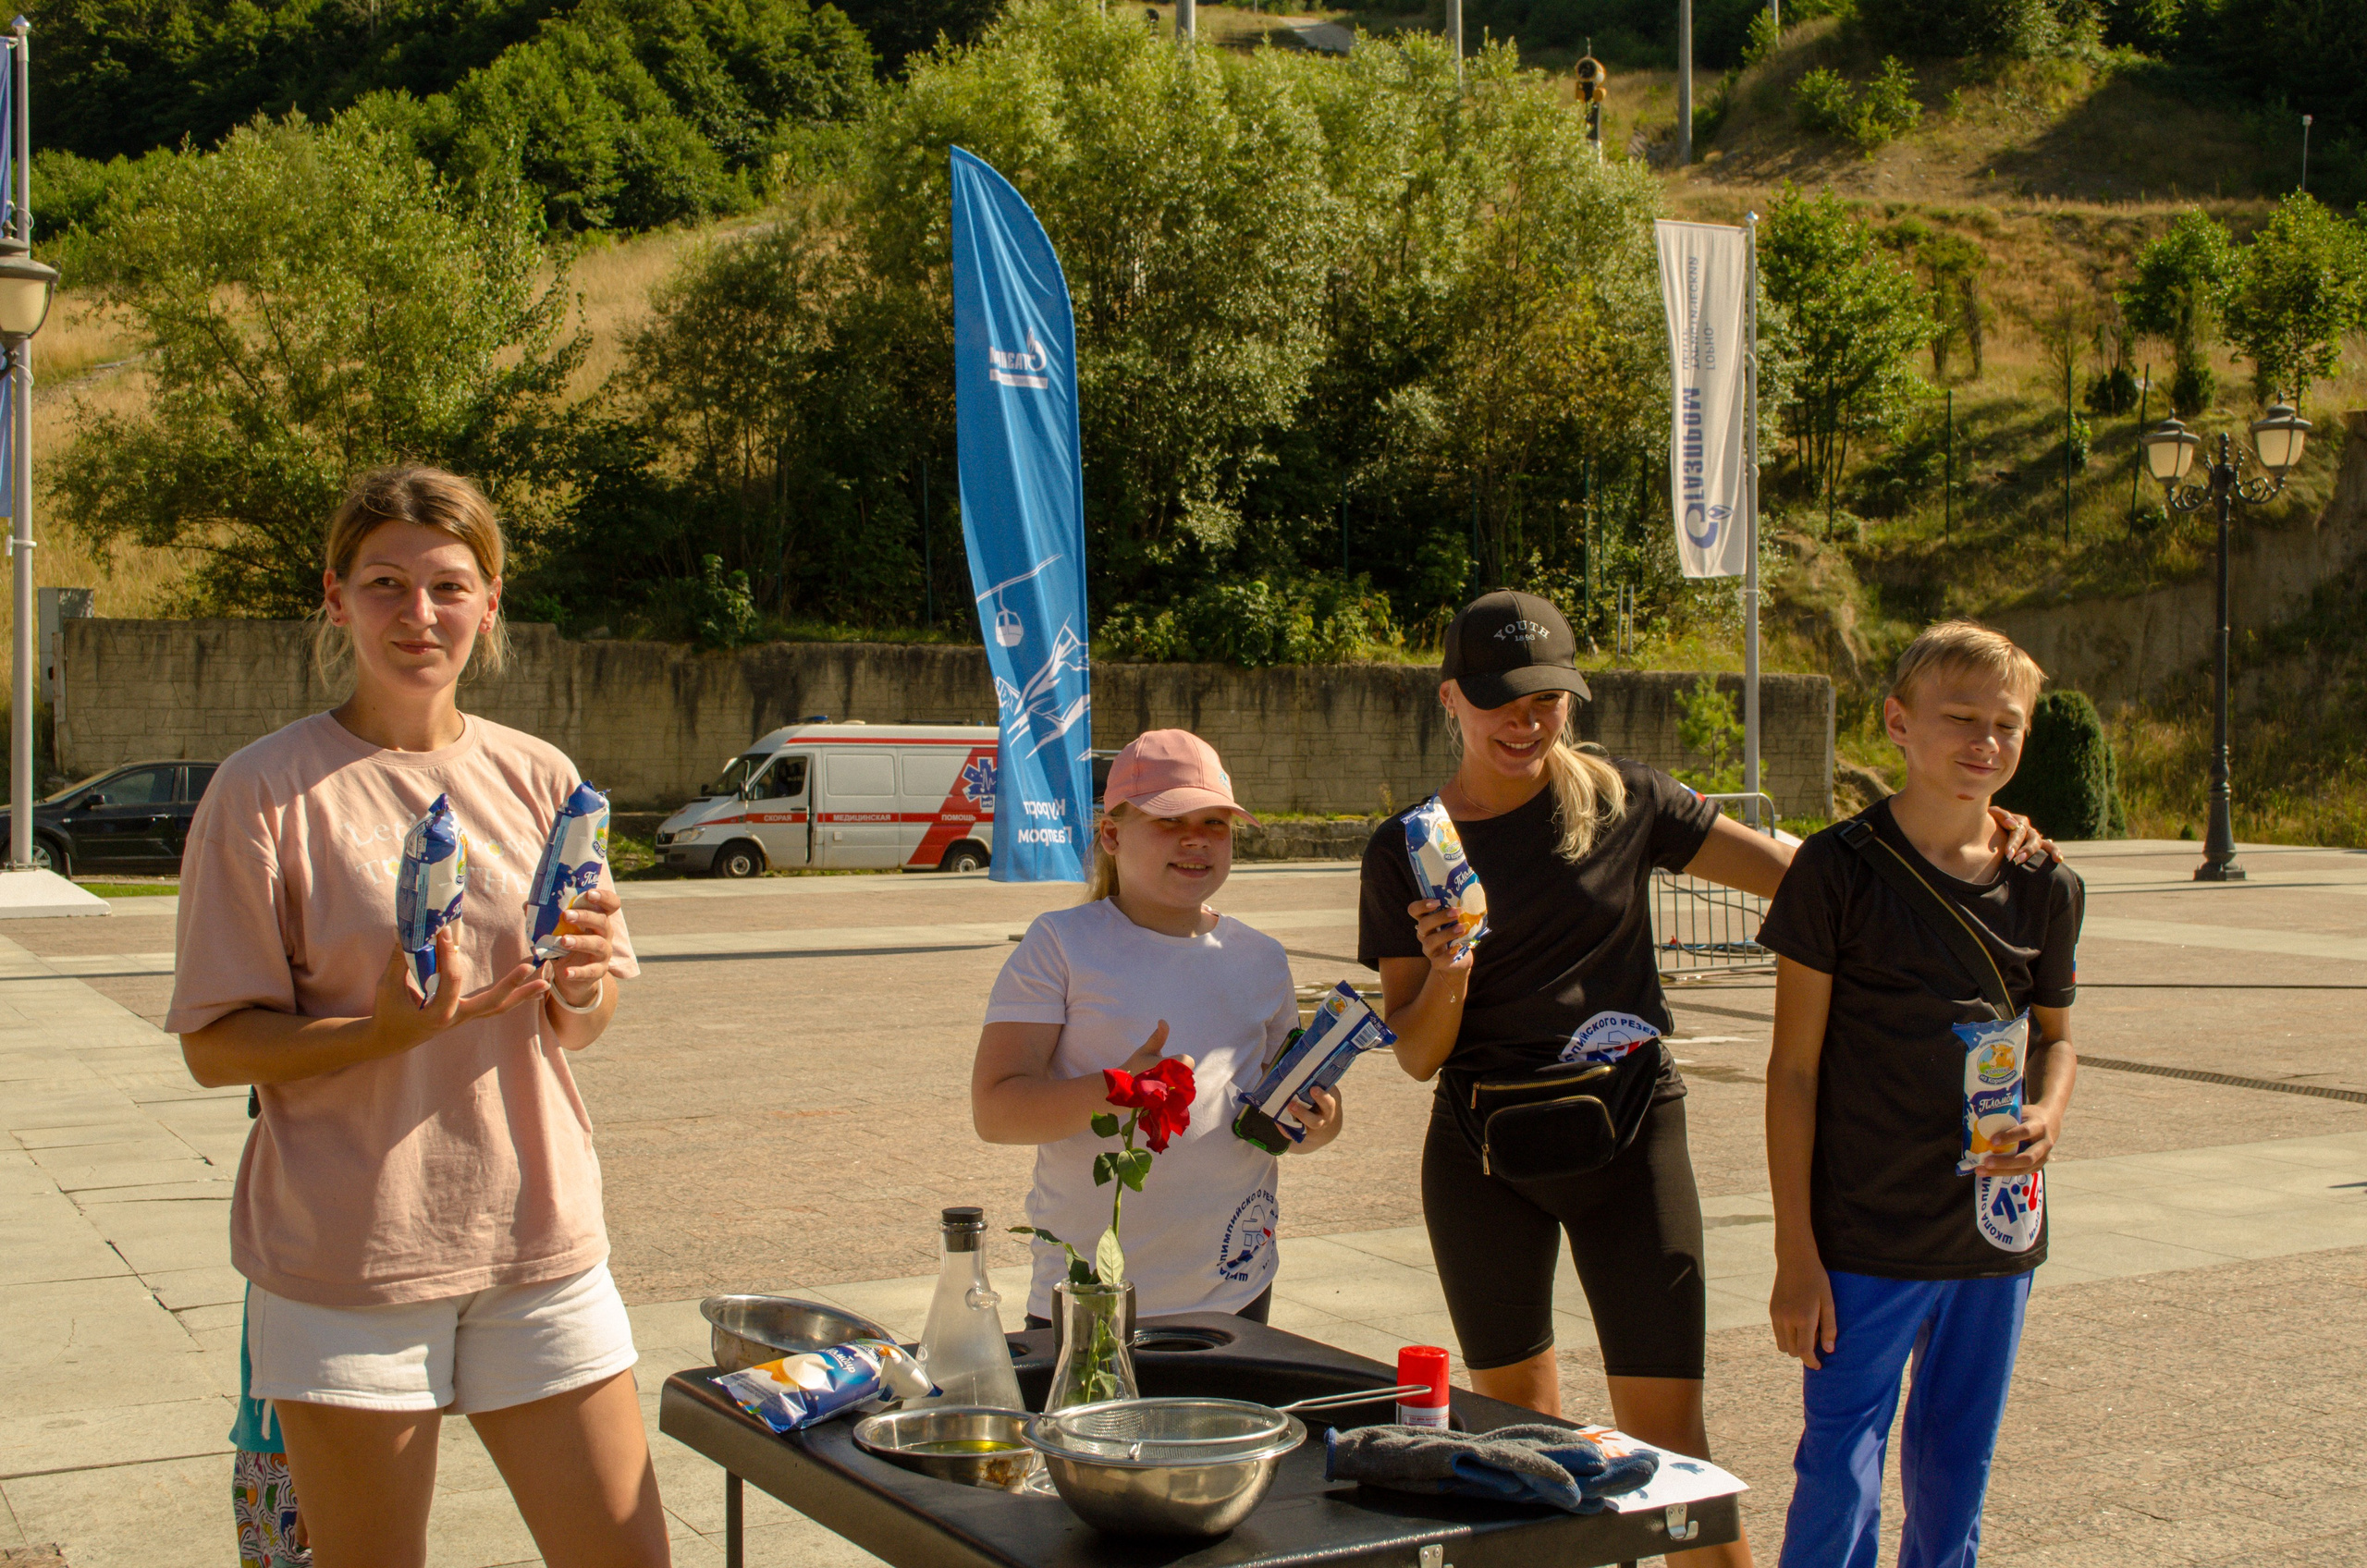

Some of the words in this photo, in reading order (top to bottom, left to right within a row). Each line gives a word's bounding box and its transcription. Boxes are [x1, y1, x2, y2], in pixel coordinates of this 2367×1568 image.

[1493, 619, 1551, 642] YOUTH
[763, 814, 792, 823] СКОРАЯ
[833, 814, 891, 822] МЕДИЦИНСКАЯ
[941, 814, 976, 823] ПОМОЩЬ
[1981, 1213, 2014, 1245] ШКОЛА
